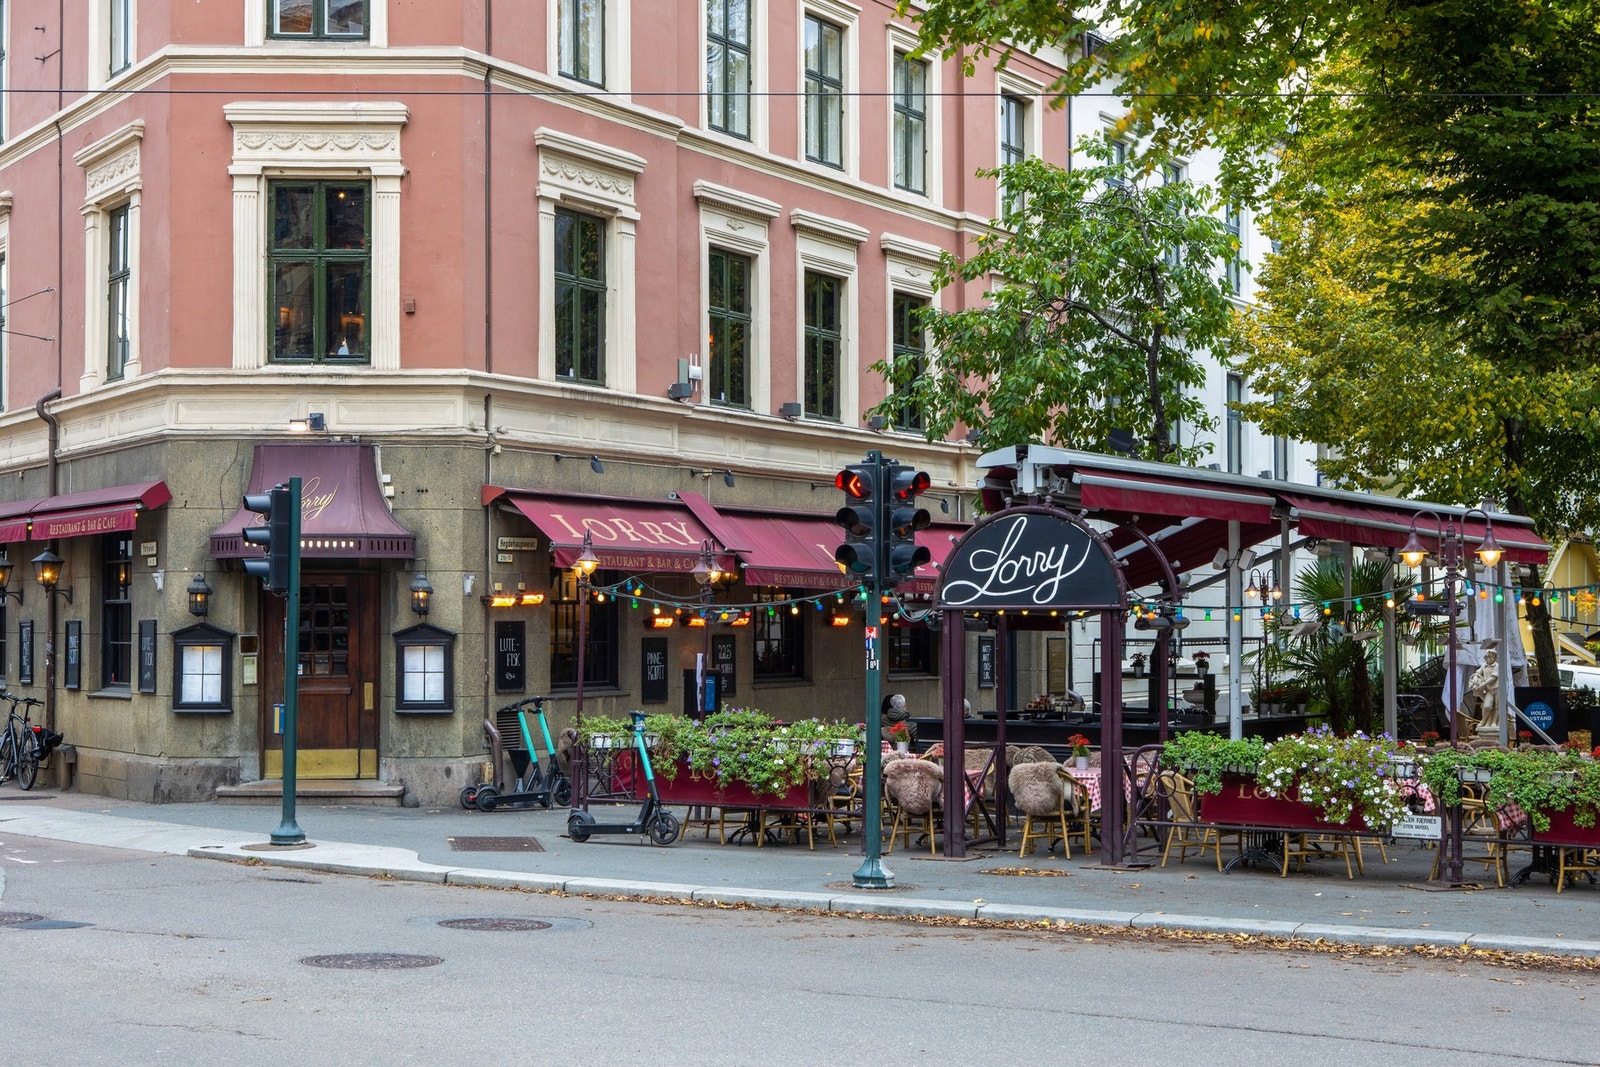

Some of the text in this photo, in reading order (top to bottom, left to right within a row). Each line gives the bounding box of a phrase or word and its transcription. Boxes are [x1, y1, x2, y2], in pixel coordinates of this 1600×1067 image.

[49, 521, 81, 535] RESTAURANT
[87, 519, 96, 531] BAR
[102, 517, 116, 529] CAFE
[550, 514, 702, 546] LORRY
[597, 555, 699, 569] ESTAURANT & BAR & CAF
[942, 516, 1092, 604] Lorry
[774, 573, 817, 586] RESTAURANT
[506, 652, 521, 667] FISK
[1237, 783, 1303, 803] LOR
[1416, 817, 1437, 825] FJERNES
